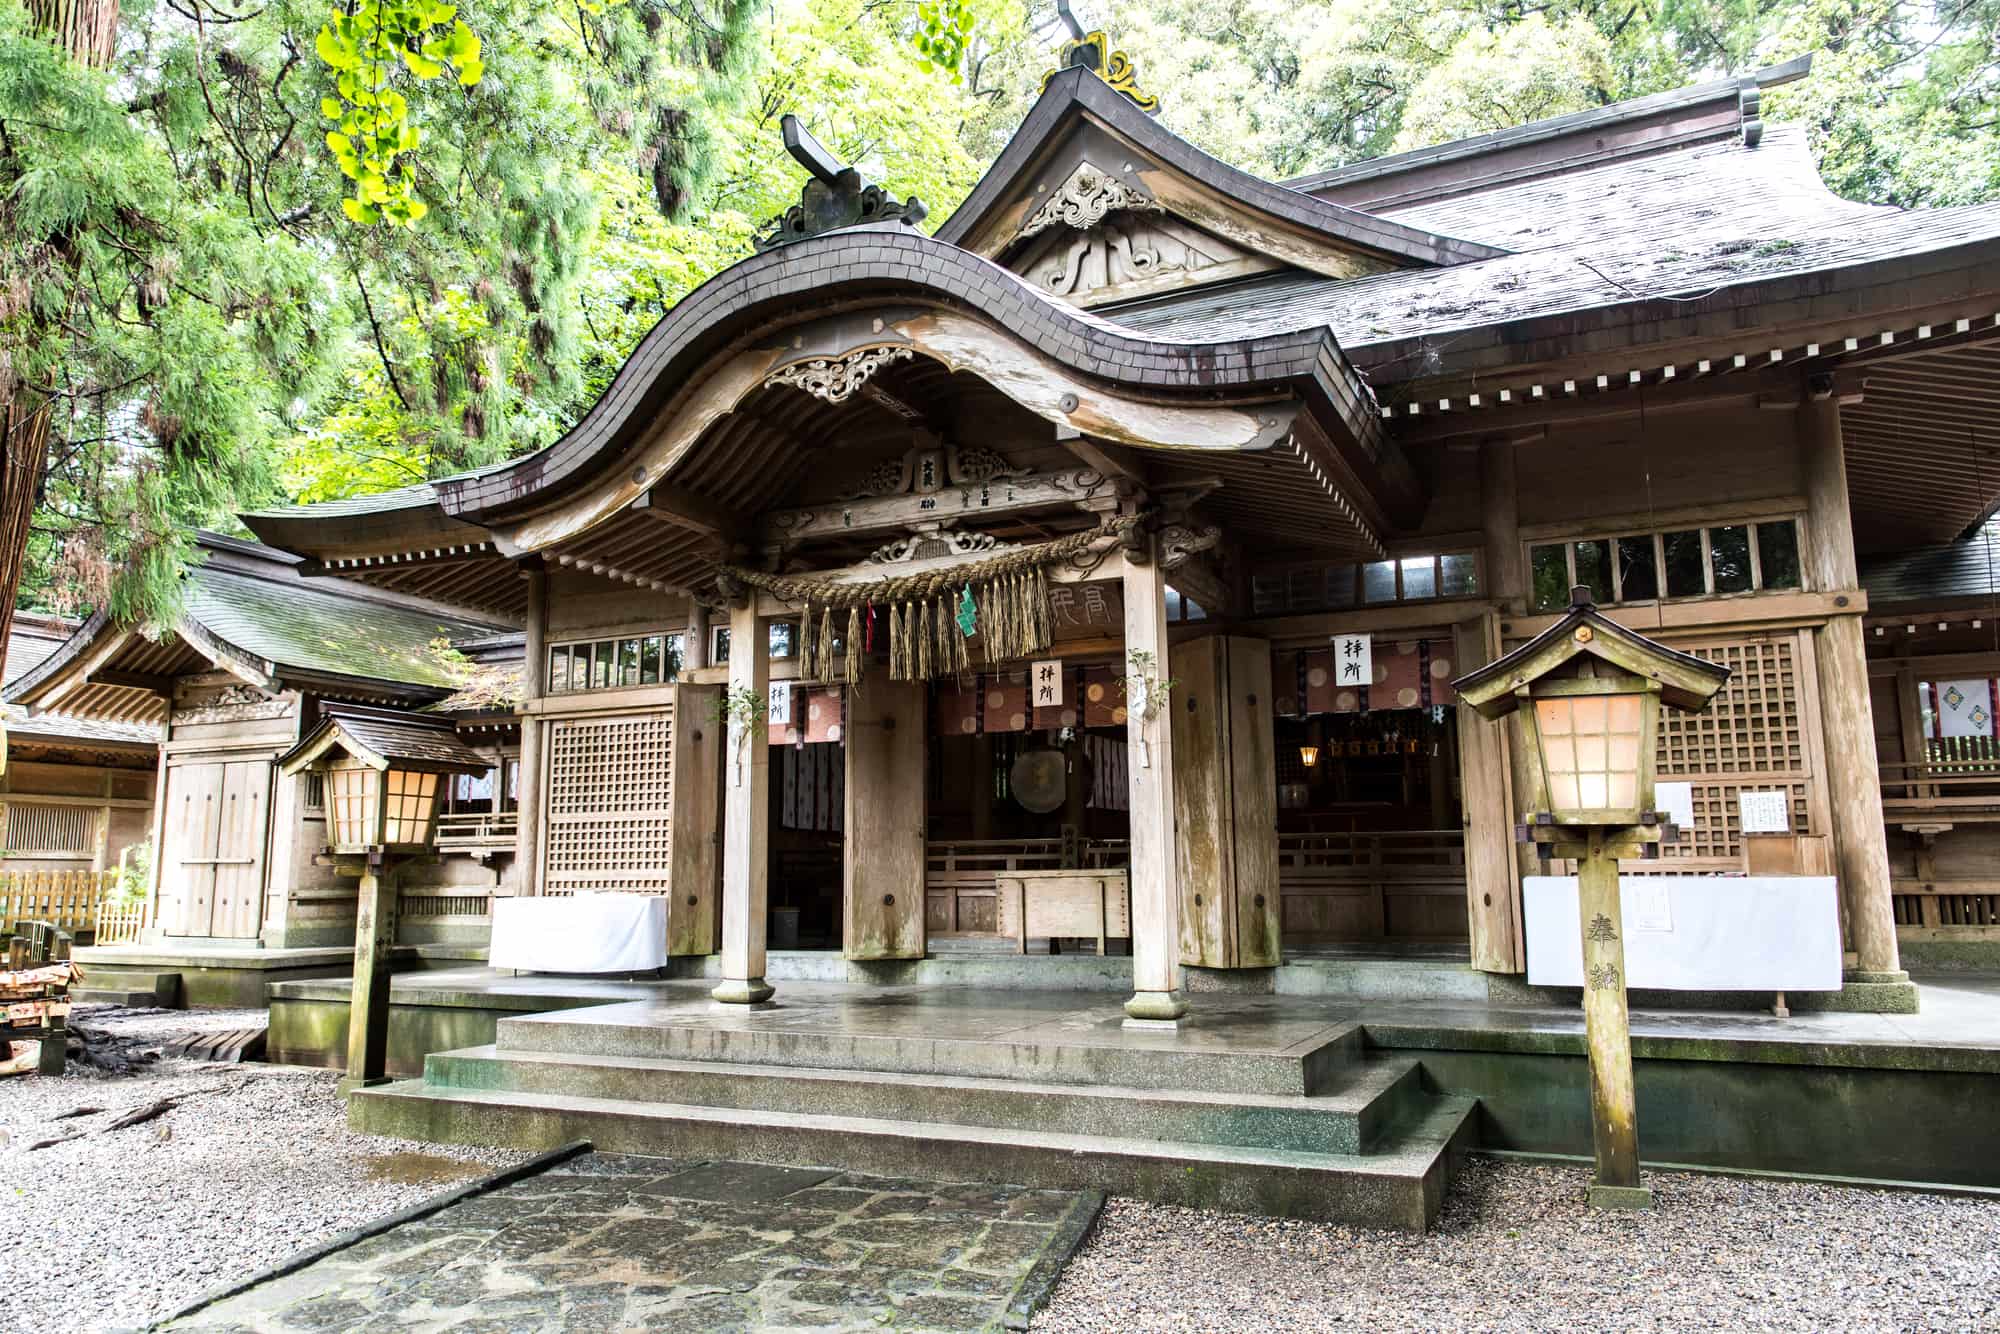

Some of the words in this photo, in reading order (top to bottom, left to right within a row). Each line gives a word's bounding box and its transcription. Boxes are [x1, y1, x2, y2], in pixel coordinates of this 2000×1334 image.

[1343, 639, 1364, 681] 拝所
[770, 686, 785, 720] 拝所
[1039, 664, 1056, 704] 拝所
[1587, 912, 1621, 992] 奉納
